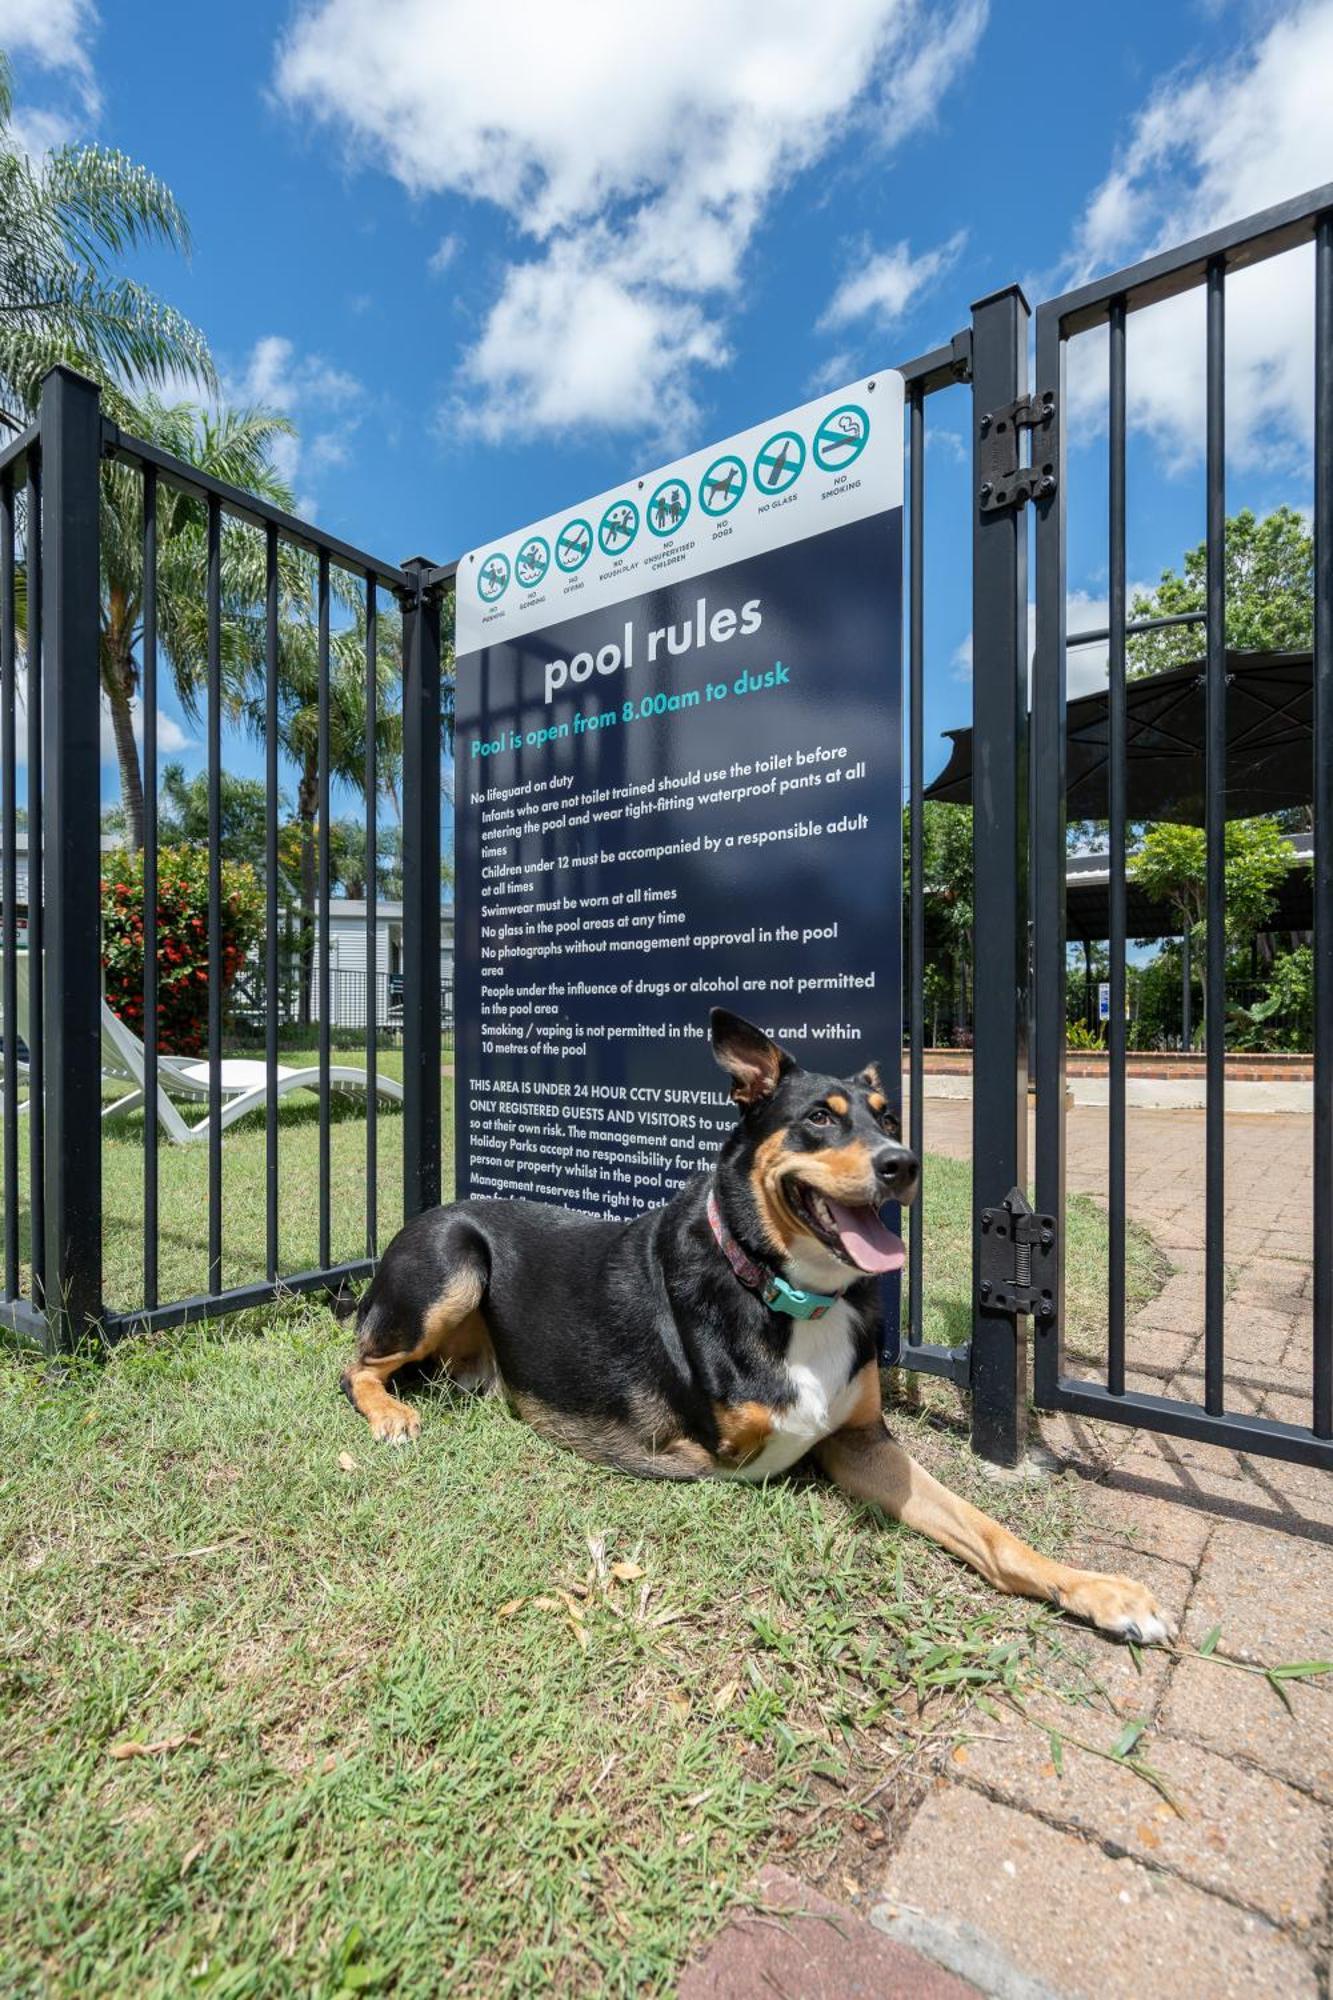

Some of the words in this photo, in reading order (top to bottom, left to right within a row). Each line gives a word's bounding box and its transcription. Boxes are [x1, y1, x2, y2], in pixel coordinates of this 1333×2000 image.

[820, 479, 862, 501] SMOKING
[833, 475, 847, 486] NO
[757, 504, 771, 515] NO
[771, 494, 798, 510] GLASS
[712, 527, 733, 540] DOGS
[716, 520, 728, 530] NO
[644, 541, 696, 565] UNSUPERVISED
[663, 540, 674, 549] NO
[651, 554, 686, 571] CHILDREN
[545, 622, 632, 704] pool
[648, 598, 761, 661] rules
[472, 732, 505, 758] Pool
[510, 731, 521, 749] is
[526, 723, 568, 748] open
[574, 712, 616, 733] from
[623, 691, 699, 721] 8.00am
[706, 683, 727, 701] to
[734, 661, 789, 694] dusk
[470, 792, 485, 804] No
[487, 780, 531, 801] lifeguard
[533, 781, 547, 792] on
[549, 775, 574, 789] duty
[482, 808, 515, 823] Infants
[516, 802, 539, 816] who
[541, 801, 559, 812] are
[561, 795, 579, 808] not
[581, 789, 610, 804] toilet
[612, 778, 655, 799] trained
[658, 769, 700, 791] should
[704, 770, 726, 782] use
[730, 762, 751, 777] the
[755, 754, 792, 773] toilet
[796, 746, 847, 765] before
[482, 825, 522, 840] entering
[524, 820, 540, 834] the
[542, 814, 566, 834] pool
[568, 810, 590, 826] and
[592, 809, 623, 822] wear
[625, 795, 694, 819] tight-fitting
[697, 777, 776, 804] waterproof
[780, 774, 821, 795] pants
[825, 768, 841, 783] at
[845, 762, 865, 780] all
[481, 864, 521, 879] Children
[524, 858, 555, 873] under
[557, 856, 569, 868] 12
[572, 853, 598, 867] must
[601, 850, 615, 863] be
[618, 836, 700, 861] accompanied
[704, 835, 722, 852] by
[725, 836, 733, 847] a
[738, 820, 822, 847] responsible
[826, 813, 868, 833] adult
[482, 846, 507, 858] times
[481, 886, 491, 896] at
[493, 882, 505, 895] all
[507, 881, 534, 893] times
[481, 904, 534, 917] Swimwear
[536, 899, 561, 912] must
[563, 896, 577, 909] be
[579, 896, 609, 907] worn
[612, 893, 624, 904] at
[626, 888, 641, 903] all
[643, 888, 677, 902] times
[481, 926, 496, 938] No
[498, 924, 523, 940] glass
[525, 922, 535, 934] in
[537, 920, 553, 933] the
[556, 917, 580, 936] pool
[582, 918, 614, 930] areas
[617, 915, 629, 927] at
[632, 916, 655, 928] any
[658, 910, 686, 924] time
[481, 946, 496, 958] No
[498, 941, 563, 960] photographs
[564, 939, 607, 953] without
[609, 934, 691, 952] management
[693, 928, 755, 950] approval
[759, 928, 772, 942] in
[775, 925, 798, 941] the
[803, 922, 838, 944] pool
[481, 967, 504, 976] area
[481, 984, 514, 999] People
[516, 982, 547, 996] under
[548, 982, 565, 995] the
[567, 981, 617, 995] influence
[620, 979, 633, 994] of
[635, 979, 670, 996] drugs
[673, 982, 688, 992] or
[690, 976, 739, 992] alcohol
[742, 980, 766, 991] are
[770, 976, 794, 990] not
[798, 971, 875, 994] permitted
[481, 1002, 490, 1014] in
[492, 1002, 507, 1014] the
[509, 1002, 532, 1017] pool
[534, 1005, 558, 1014] area
[481, 1023, 523, 1038] Smoking
[536, 1024, 572, 1039] vaping
[575, 1023, 584, 1036] is
[586, 1025, 605, 1036] not
[607, 1022, 665, 1040] permitted
[669, 1024, 680, 1037] in
[683, 1023, 704, 1037] the
[778, 1023, 807, 1038] and
[811, 1023, 861, 1039] within
[482, 1041, 493, 1053] 10
[495, 1043, 528, 1054] metres
[530, 1041, 541, 1054] of
[543, 1042, 559, 1055] the
[561, 1042, 586, 1058] pool
[469, 1078, 491, 1091] THIS
[492, 1080, 519, 1093] AREA
[521, 1081, 531, 1094] IS
[533, 1082, 571, 1096] UNDER
[574, 1084, 588, 1097] 24
[591, 1085, 627, 1099] HOUR
[630, 1088, 661, 1101] CCTV
[469, 1099, 497, 1112] ONLY
[499, 1101, 559, 1117] REGISTERED
[562, 1106, 604, 1121] GUESTS
[607, 1109, 635, 1123] AND
[637, 1112, 696, 1128] VISITORS
[699, 1117, 712, 1130] to
[470, 1120, 480, 1128] so
[482, 1120, 492, 1129] at
[494, 1118, 516, 1132] their
[518, 1124, 540, 1134] own
[543, 1123, 566, 1136] risk.
[568, 1125, 587, 1139] The
[589, 1130, 667, 1146] management
[670, 1135, 694, 1149] and
[470, 1134, 508, 1152] Holiday
[510, 1138, 537, 1152] Parks
[540, 1145, 573, 1159] accept
[576, 1148, 590, 1158] no
[592, 1150, 672, 1170] responsibility
[675, 1154, 694, 1169] for
[470, 1154, 502, 1166] person
[504, 1158, 515, 1168] or
[517, 1160, 562, 1177] property
[564, 1163, 597, 1178] whilst
[600, 1166, 610, 1180] in
[613, 1168, 631, 1183] the
[634, 1173, 661, 1188] pool
[470, 1172, 534, 1192] Management
[535, 1184, 580, 1199] reserves
[582, 1187, 599, 1201] the
[602, 1190, 630, 1207] right
[632, 1196, 644, 1208] to
